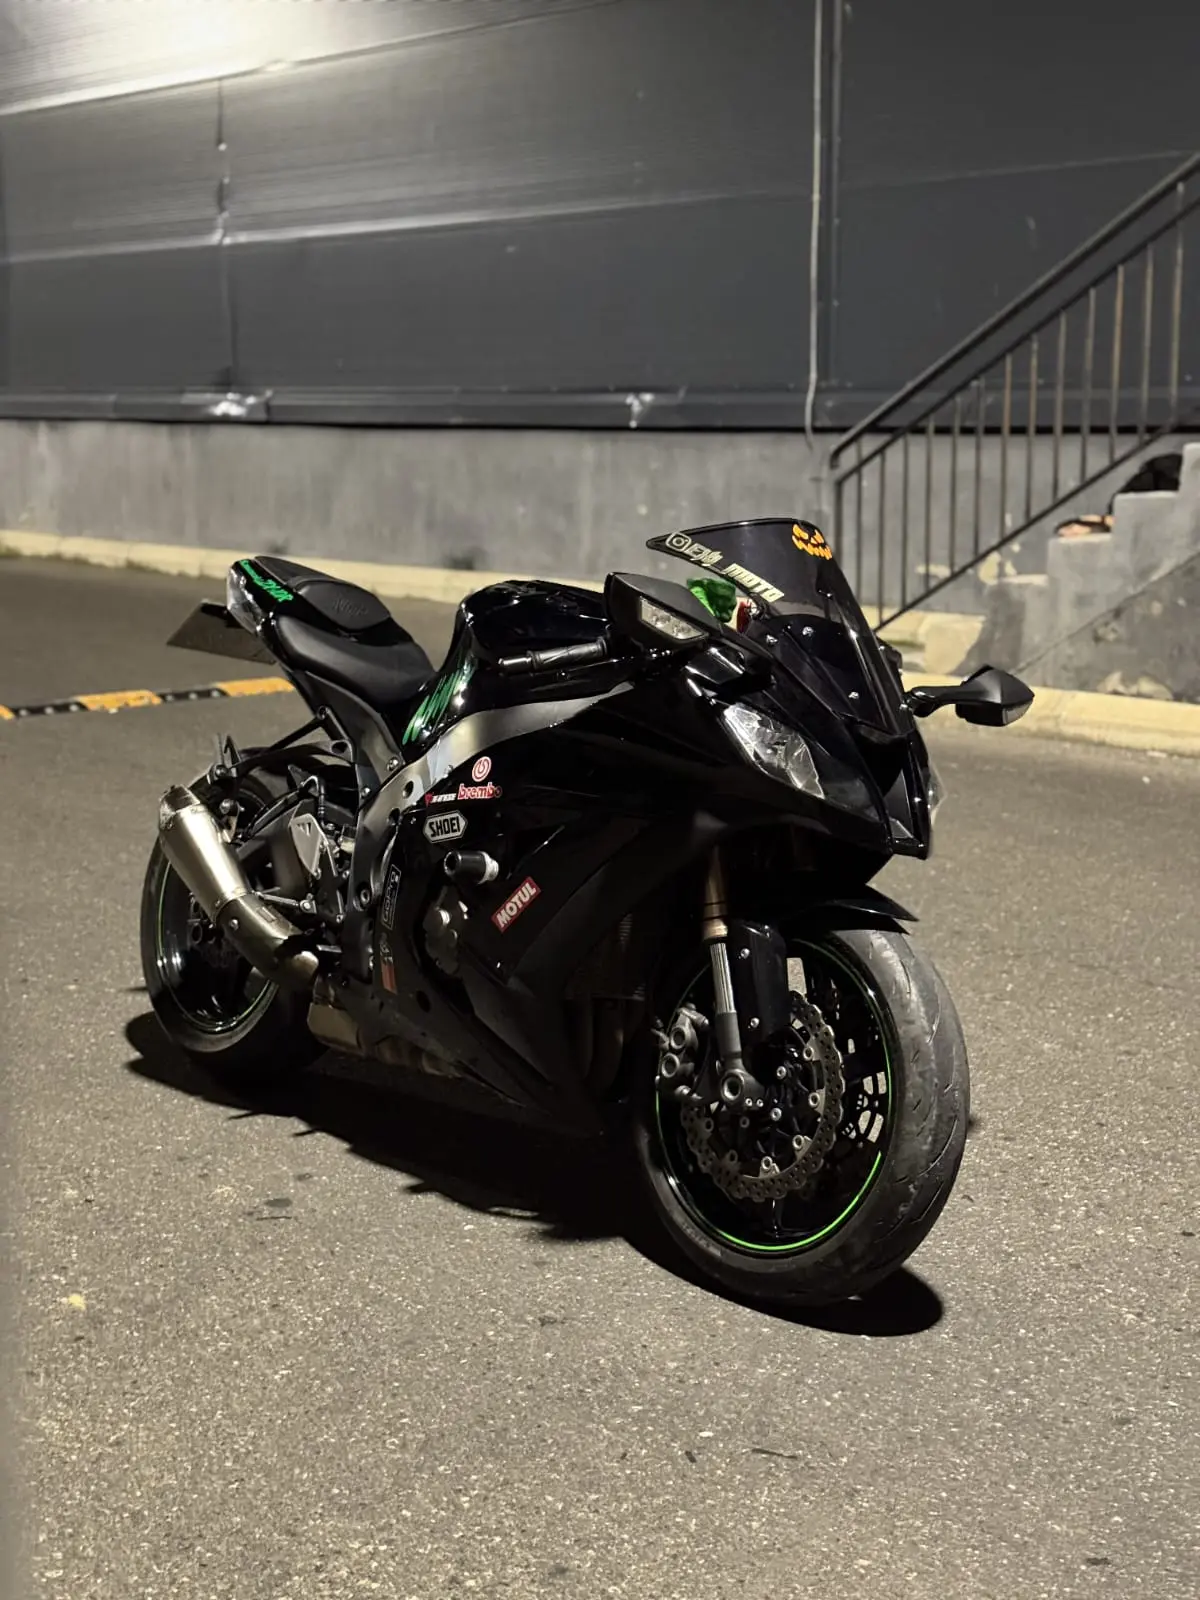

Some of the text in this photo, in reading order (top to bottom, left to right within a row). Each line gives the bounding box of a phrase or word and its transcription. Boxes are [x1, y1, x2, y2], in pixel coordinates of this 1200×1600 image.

[457, 782, 503, 800] brembo
[429, 816, 460, 837] SHOEI
[497, 882, 537, 927] MOTUL
